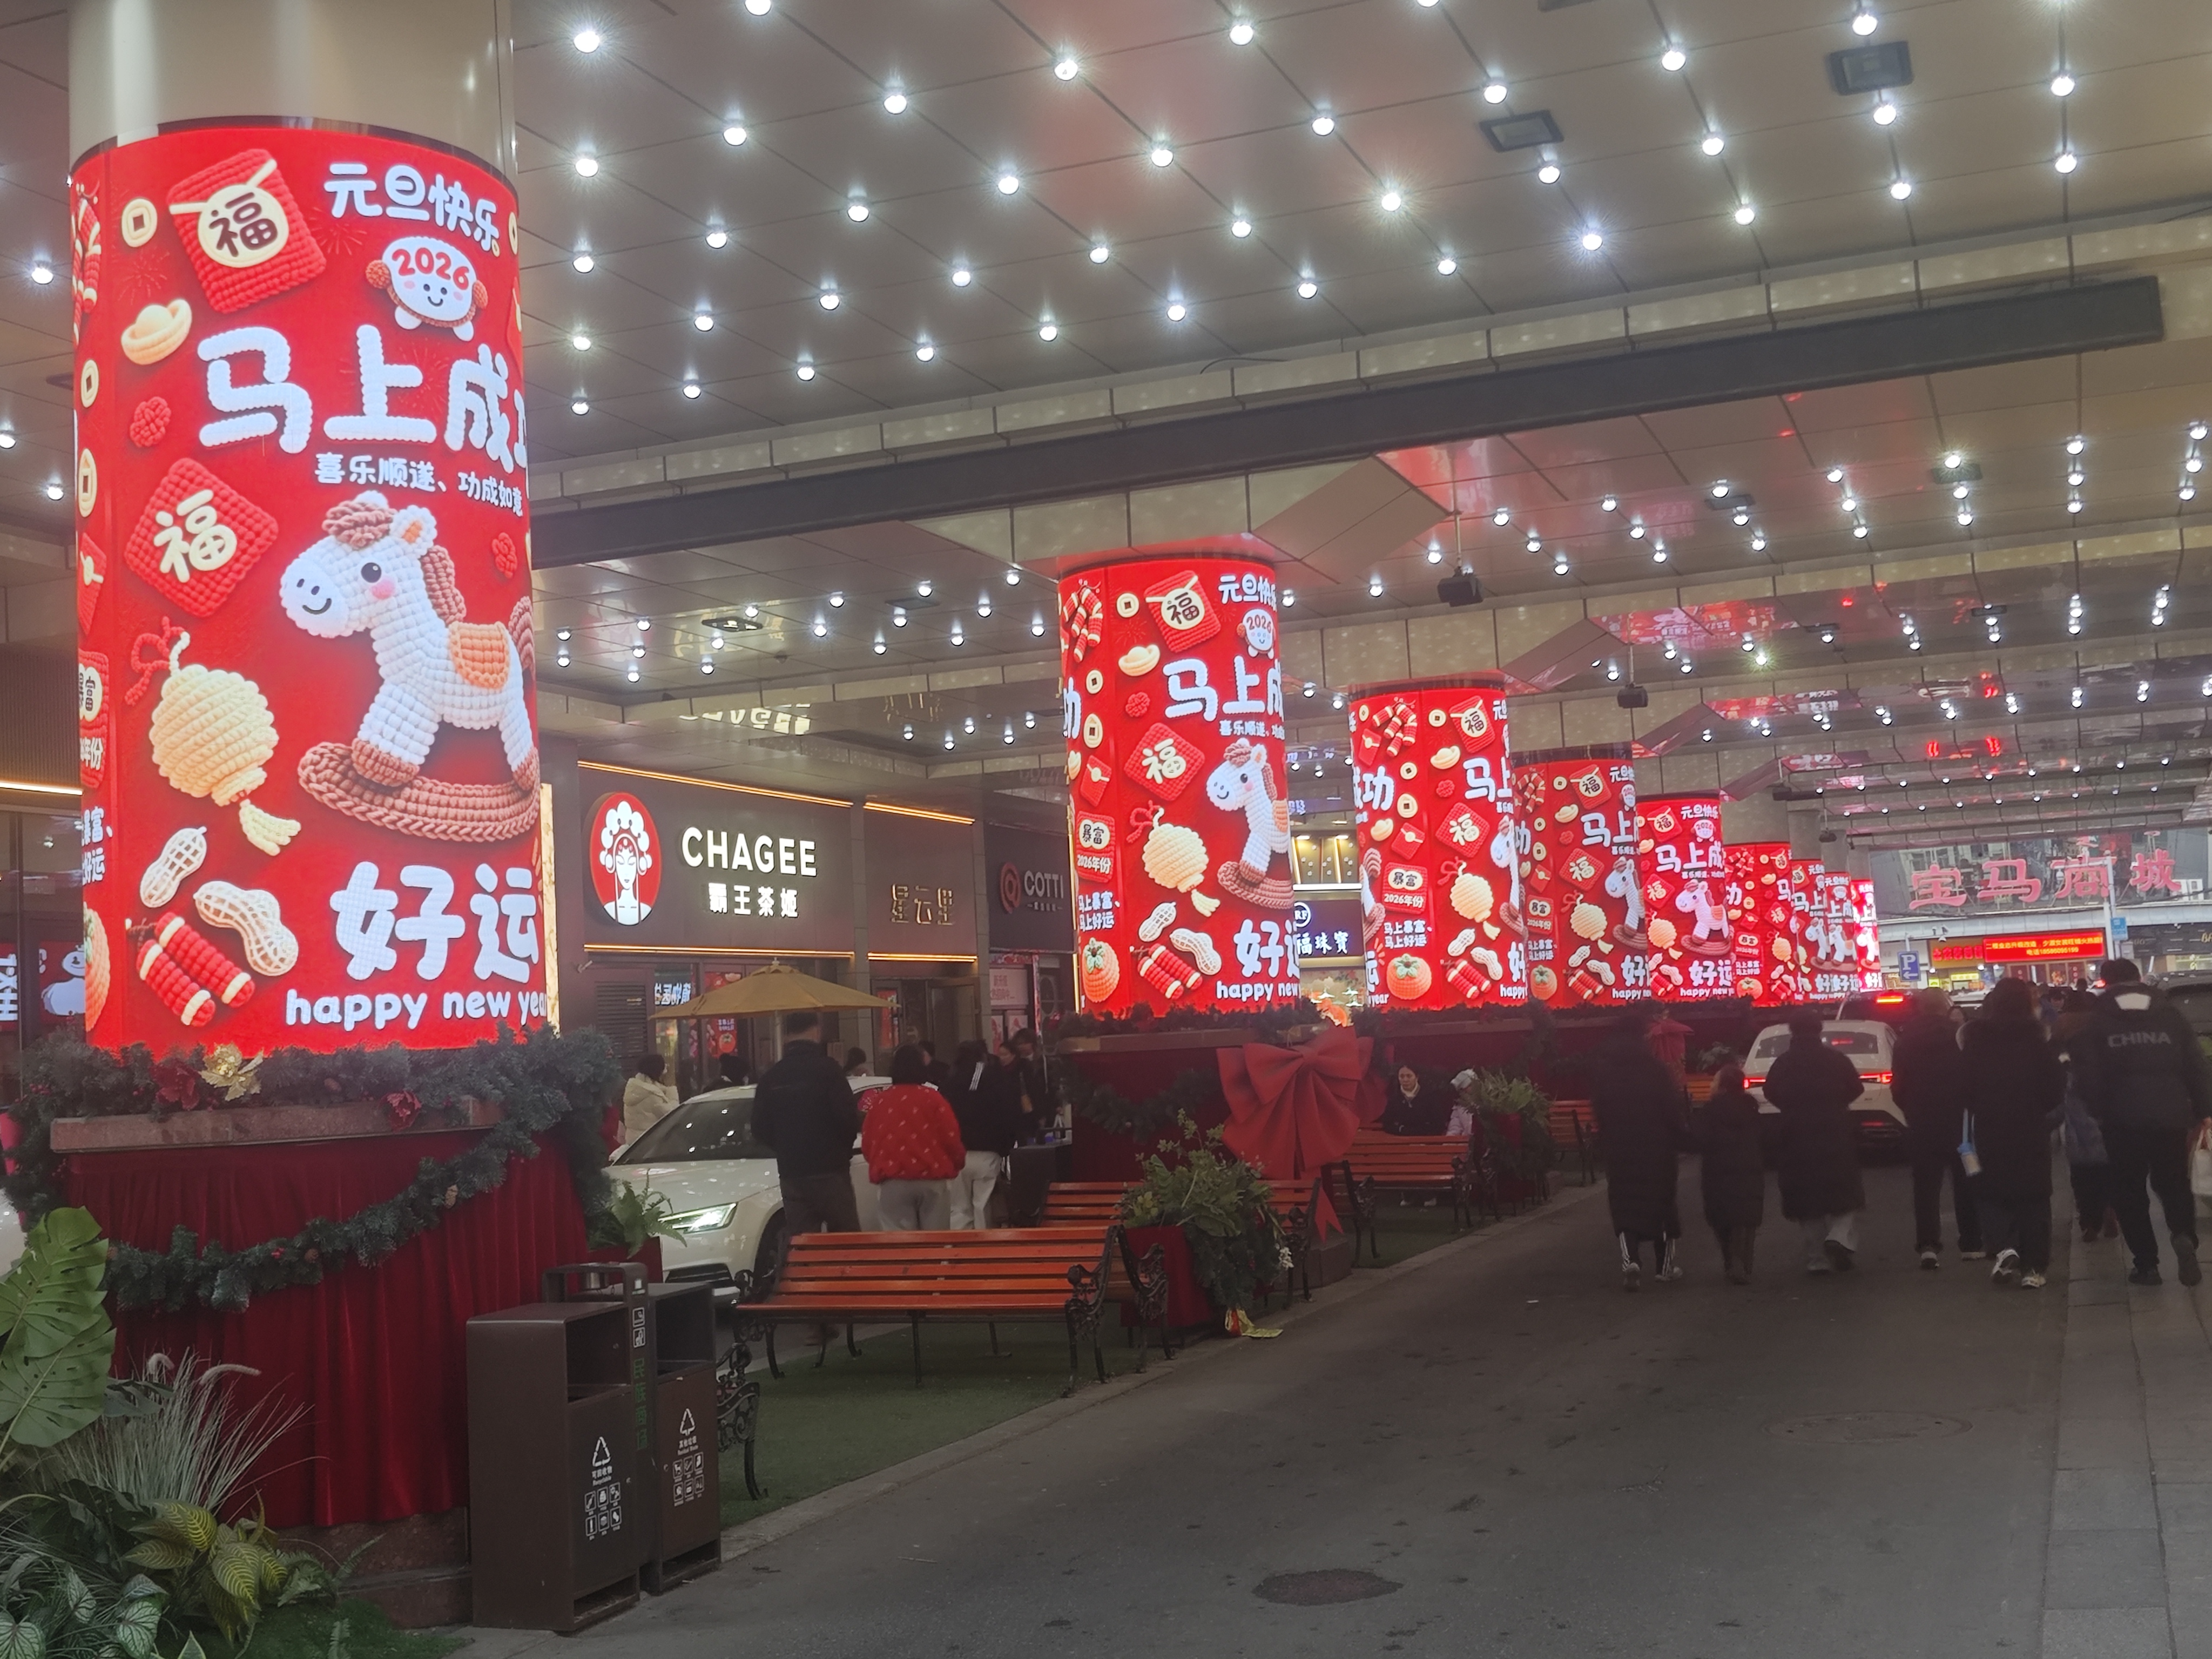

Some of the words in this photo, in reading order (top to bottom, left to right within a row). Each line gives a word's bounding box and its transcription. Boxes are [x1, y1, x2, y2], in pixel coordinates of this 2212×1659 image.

[324, 164, 499, 251] 元旦快乐
[210, 192, 278, 257] 福
[392, 247, 469, 290] 2026
[154, 488, 237, 583] 福
[1166, 592, 1200, 625] 福
[1246, 615, 1272, 633] 2026
[1465, 711, 1485, 734] 福
[1142, 738, 1186, 785] 福
[1582, 776, 1600, 794] 福
[1449, 813, 1480, 846] 福
[1656, 815, 1672, 830] 福
[1082, 824, 1104, 845] 暴富
[682, 826, 817, 876] CHAGEE
[1392, 872, 1418, 887] 暴富
[1569, 856, 1595, 881] 福
[1910, 848, 2182, 910] 宝马商城
[1024, 870, 1064, 899] COTTI
[1647, 880, 1667, 901] 福
[708, 882, 798, 918] 霸王茶姬
[1384, 893, 1424, 908] 2026年份
[330, 861, 539, 983] 好运
[1771, 907, 1786, 924] 福
[1384, 934, 1427, 949] 马上好运
[1901, 954, 1917, 970] P
[1216, 980, 1274, 1002] happy
[1612, 988, 1641, 1000] happy
[1680, 987, 1711, 997] happy
[286, 989, 427, 1031] happy
[442, 991, 511, 1019] new
[2108, 1031, 2171, 1048] CHINA
